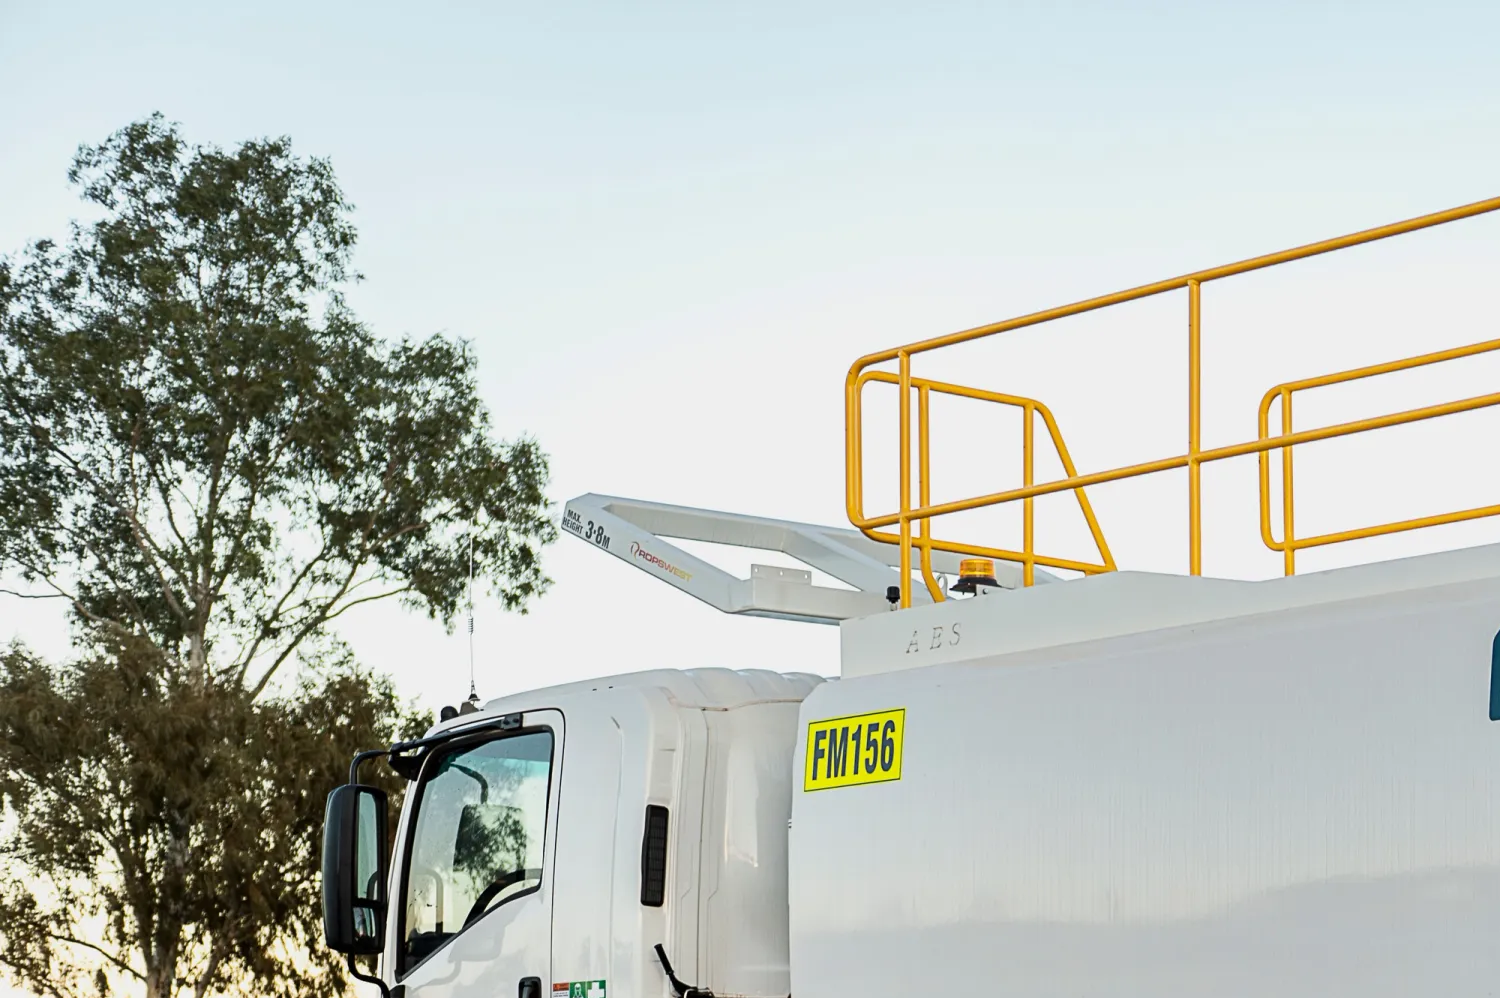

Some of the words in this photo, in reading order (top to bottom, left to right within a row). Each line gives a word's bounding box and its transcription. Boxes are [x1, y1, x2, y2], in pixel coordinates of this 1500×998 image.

[562, 516, 583, 534] HEIGHT
[567, 509, 582, 524] MAX.
[811, 719, 896, 781] FM156
